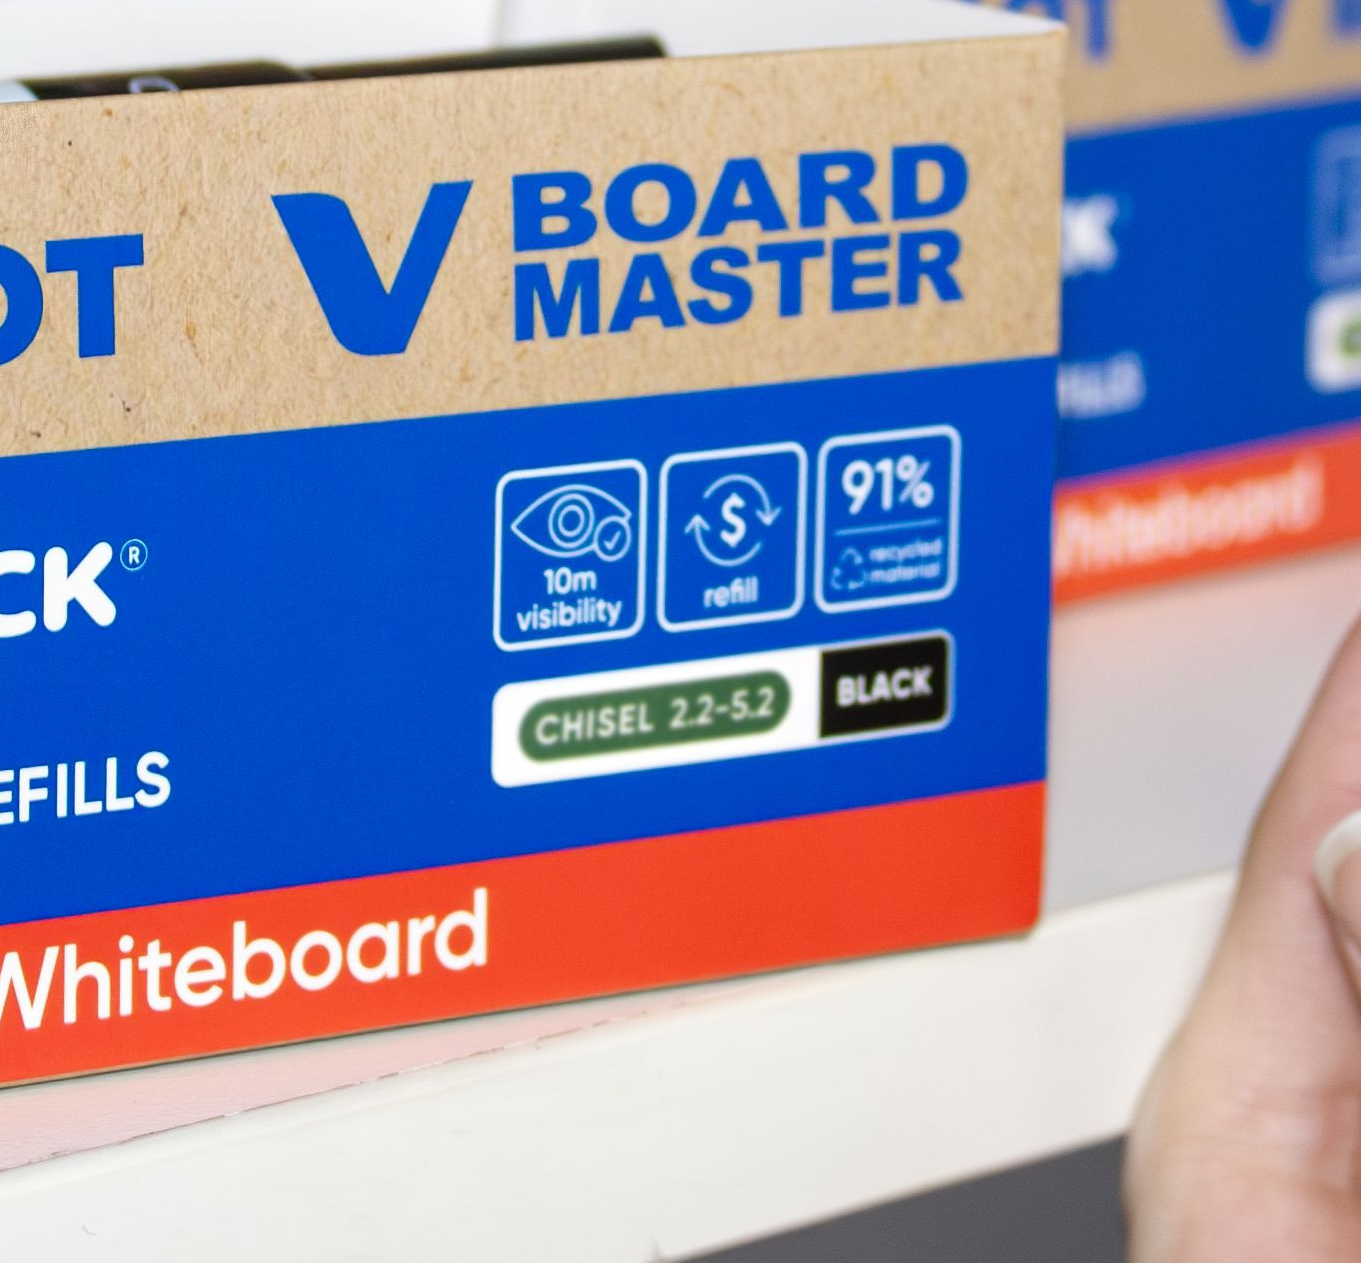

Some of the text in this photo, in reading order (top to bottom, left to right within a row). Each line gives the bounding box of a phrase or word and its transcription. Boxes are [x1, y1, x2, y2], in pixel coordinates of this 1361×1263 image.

[511, 144, 969, 252] BOARD
[271, 180, 474, 356] V
[514, 229, 964, 342] MASTER
[841, 454, 935, 515] 91%
[543, 566, 597, 596] 10m
[704, 576, 759, 609] refill
[516, 597, 622, 632] visibility
[836, 665, 934, 707] BLACK
[534, 687, 776, 746] CHISEL 2.2-5.2
